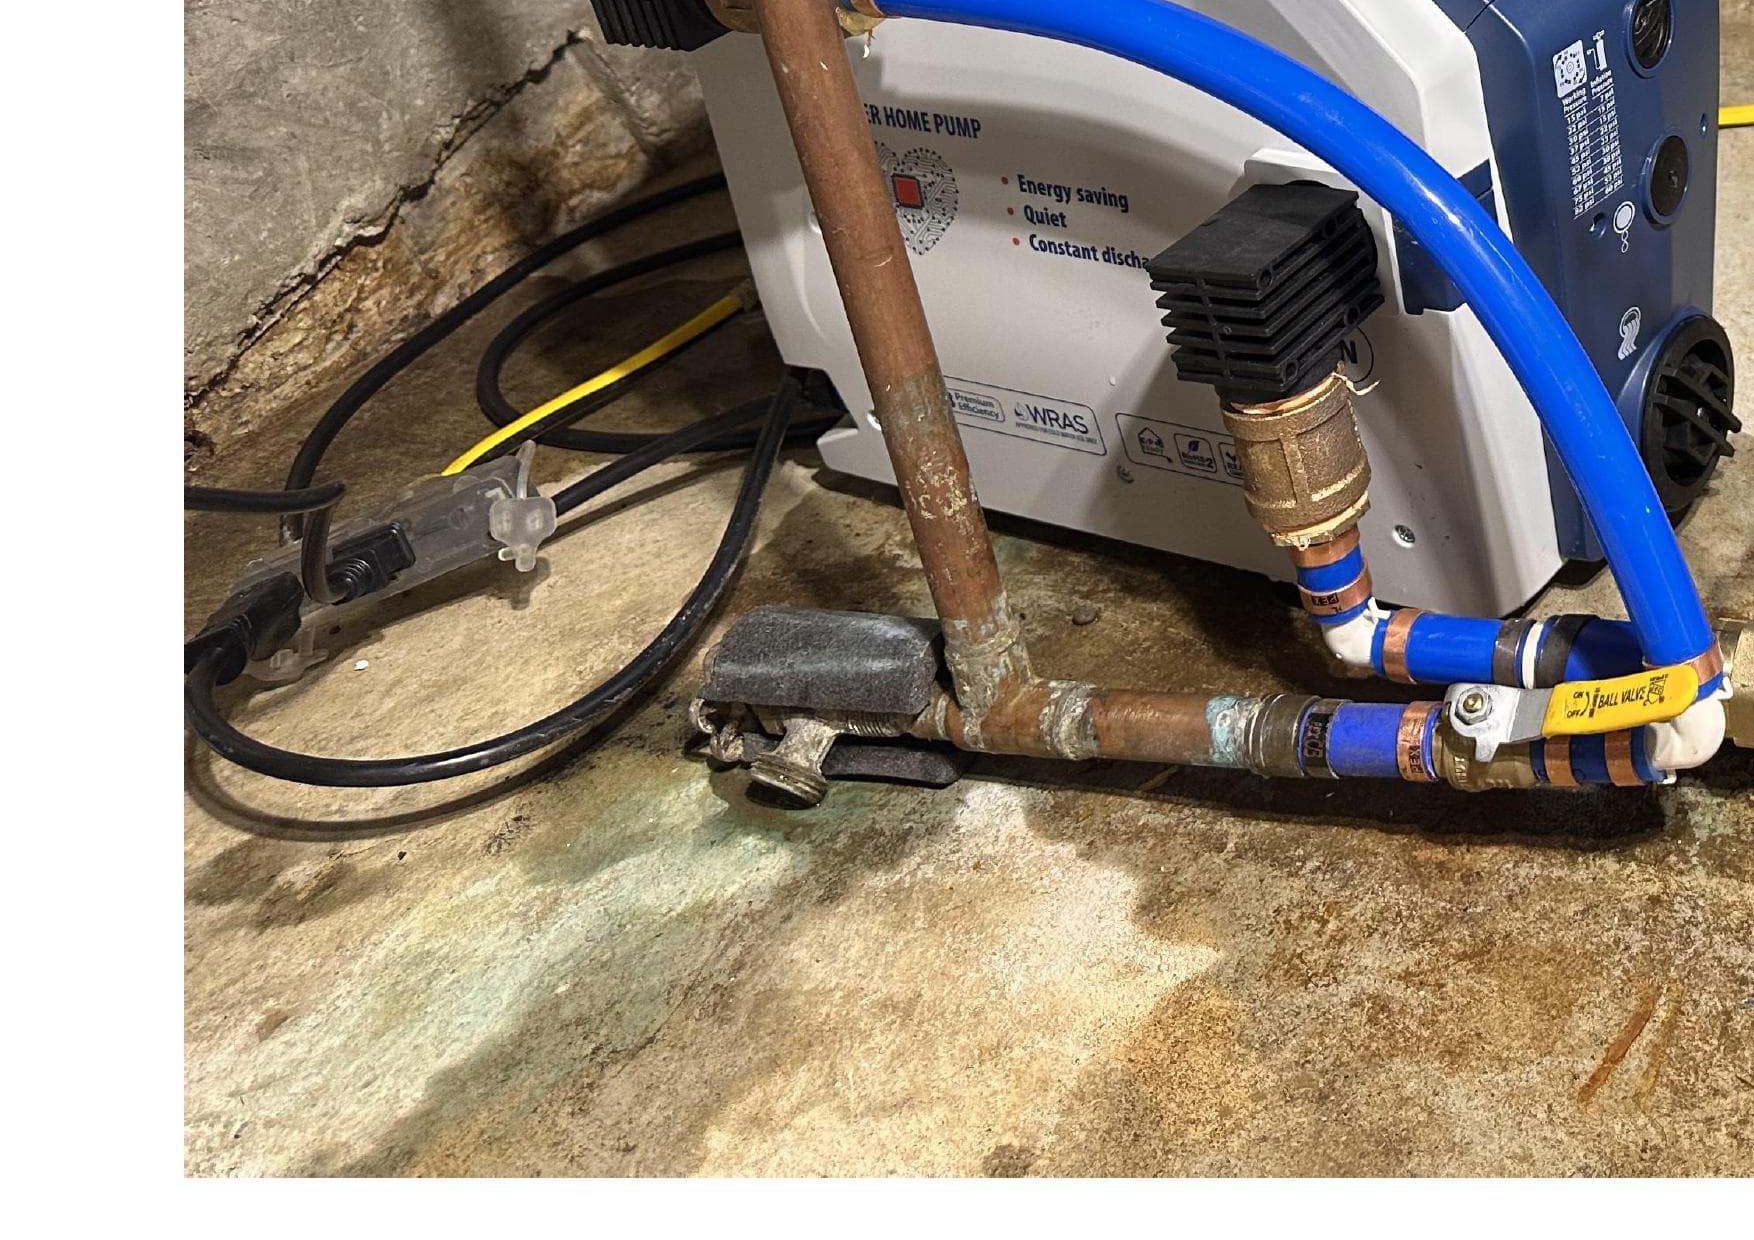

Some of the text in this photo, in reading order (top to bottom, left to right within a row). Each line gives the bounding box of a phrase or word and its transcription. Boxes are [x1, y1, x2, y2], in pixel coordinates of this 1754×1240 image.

[1562, 88, 1586, 106] Working
[883, 106, 931, 132] HOME
[934, 113, 981, 139] PUMP
[1017, 174, 1129, 213] Energy saving
[1024, 204, 1067, 228] Quiet
[1029, 234, 1099, 262] Constant
[1340, 340, 1358, 364] N
[954, 392, 994, 408] Premium
[958, 401, 1000, 420] Efficiency
[1026, 405, 1089, 434] WRAS
[1598, 693, 1618, 709] BALL
[1621, 686, 1646, 706] VALVE
[1567, 710, 1579, 718] OFF
[1409, 745, 1424, 774] PEX
